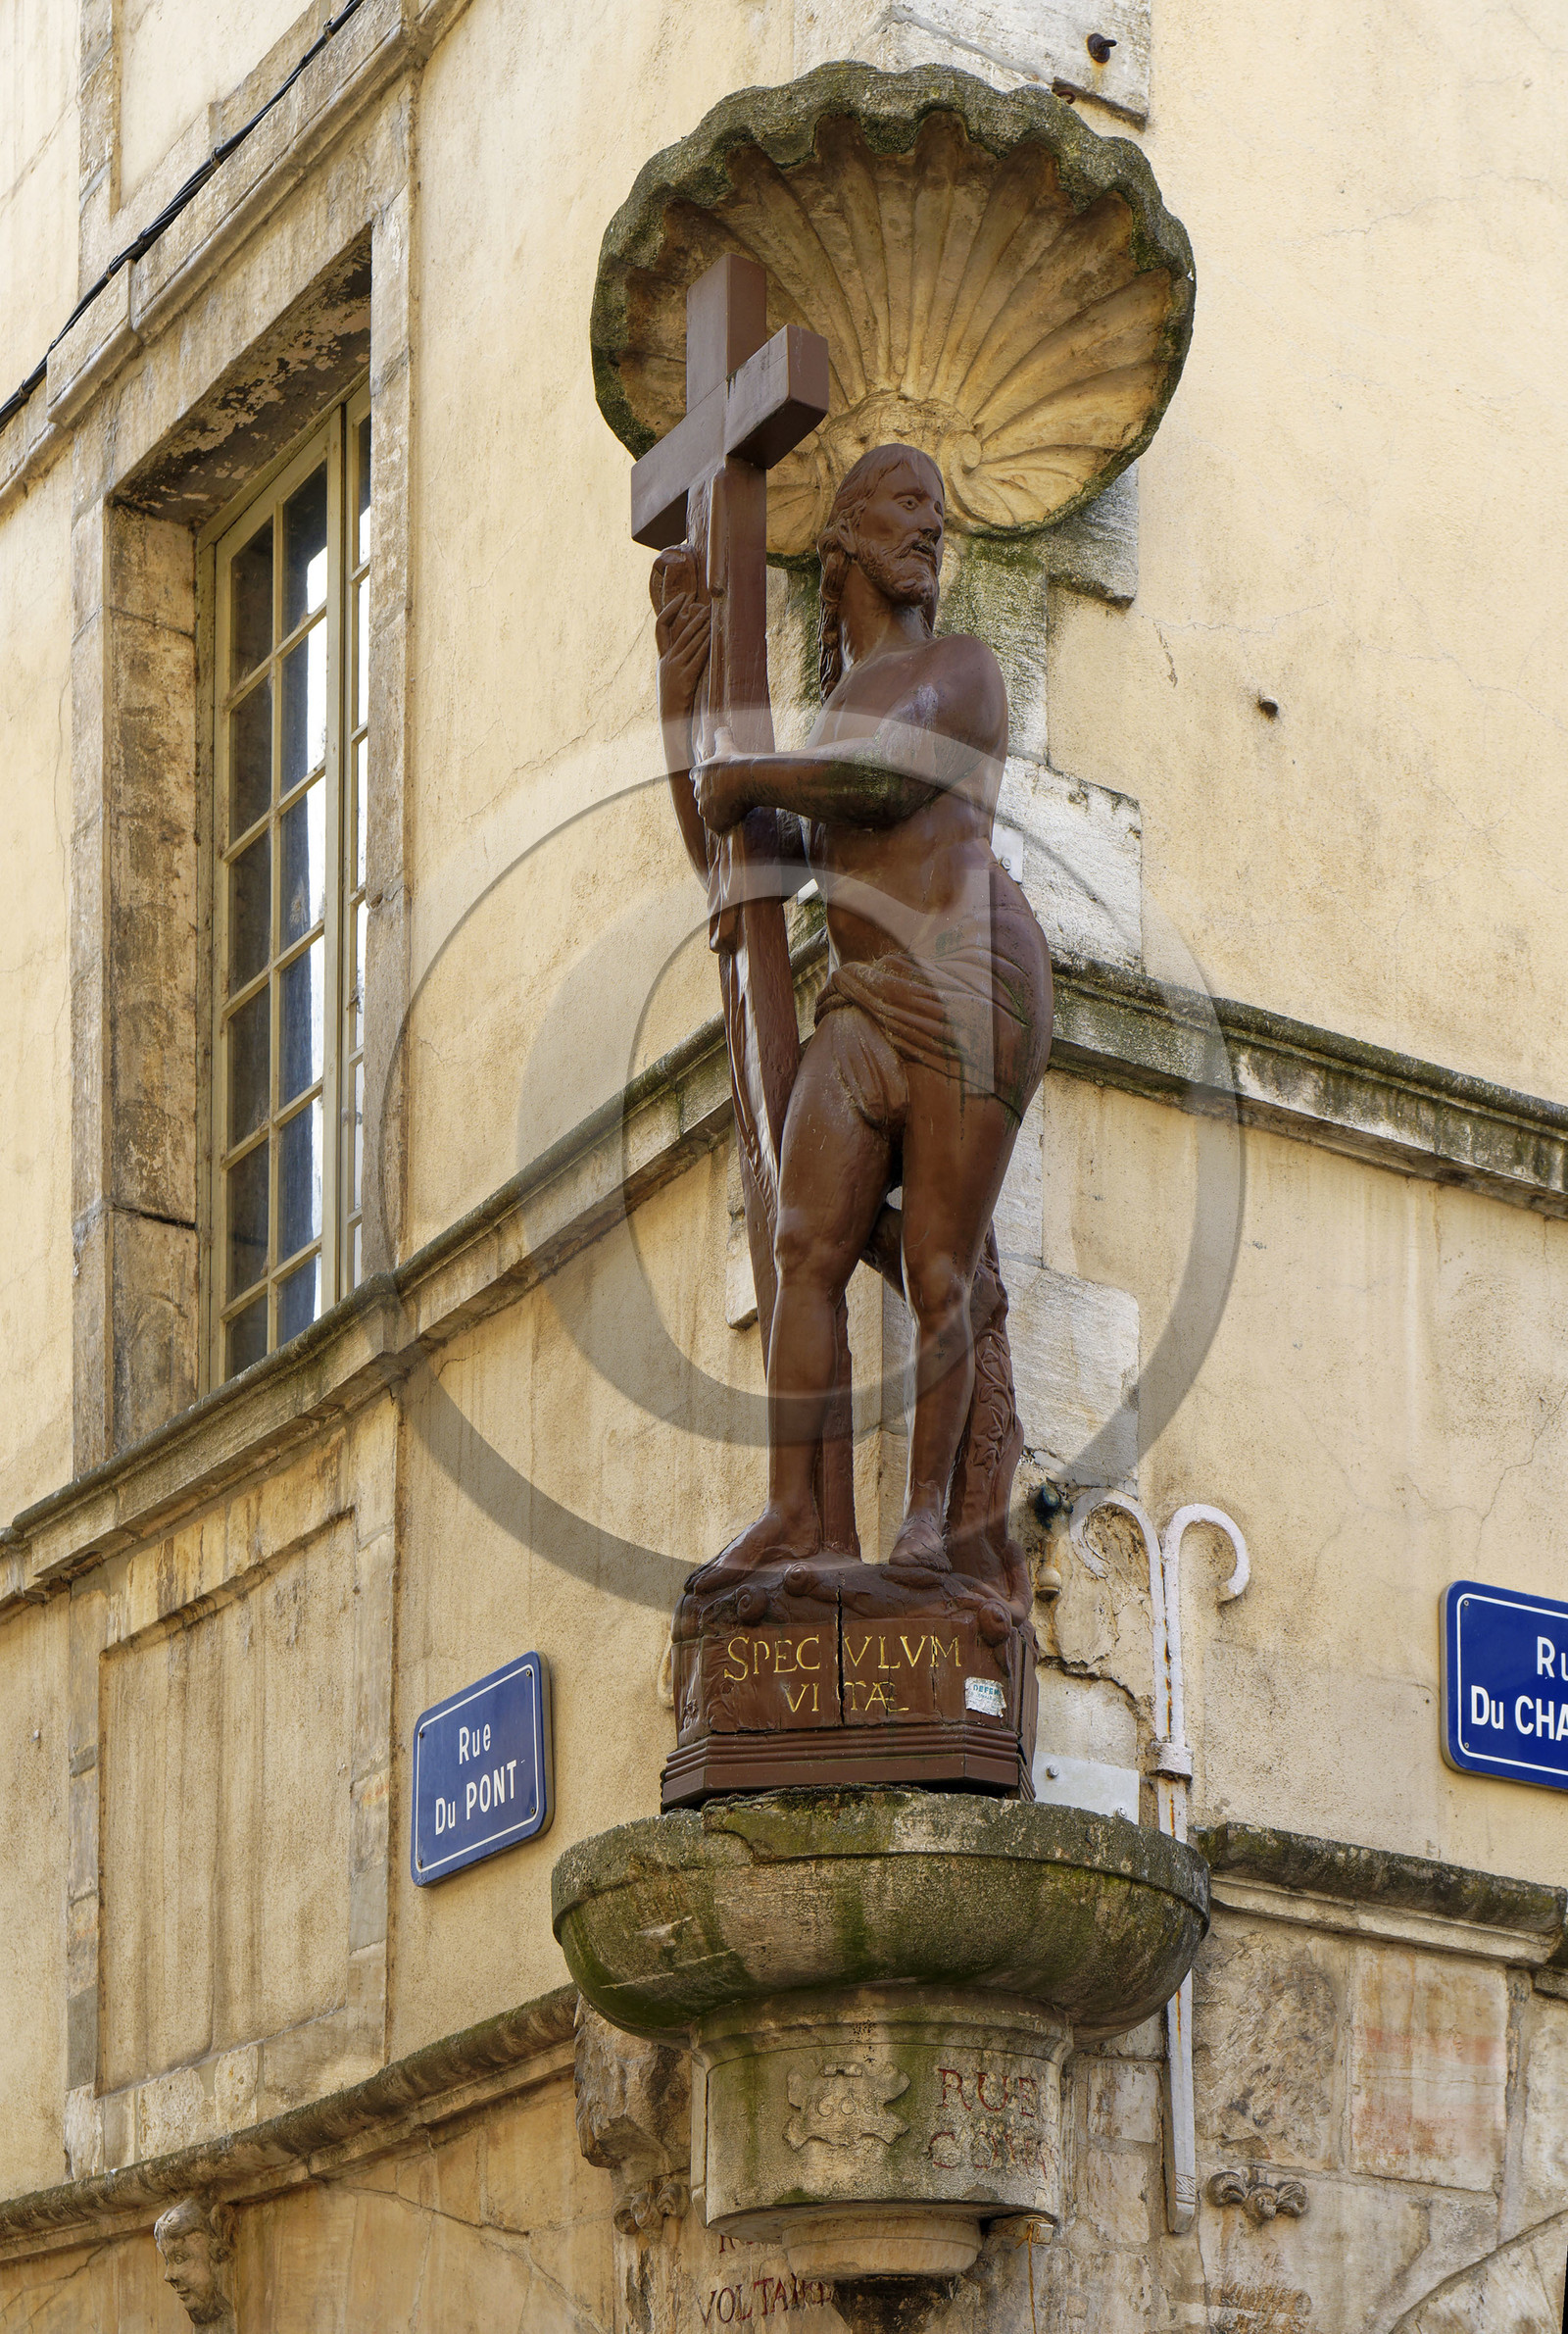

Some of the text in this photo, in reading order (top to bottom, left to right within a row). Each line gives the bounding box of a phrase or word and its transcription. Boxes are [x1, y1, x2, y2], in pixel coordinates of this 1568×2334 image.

[1471, 1684, 1504, 1730] Du
[459, 1722, 491, 1764] Rue
[435, 1760, 517, 1836] Du PONT
